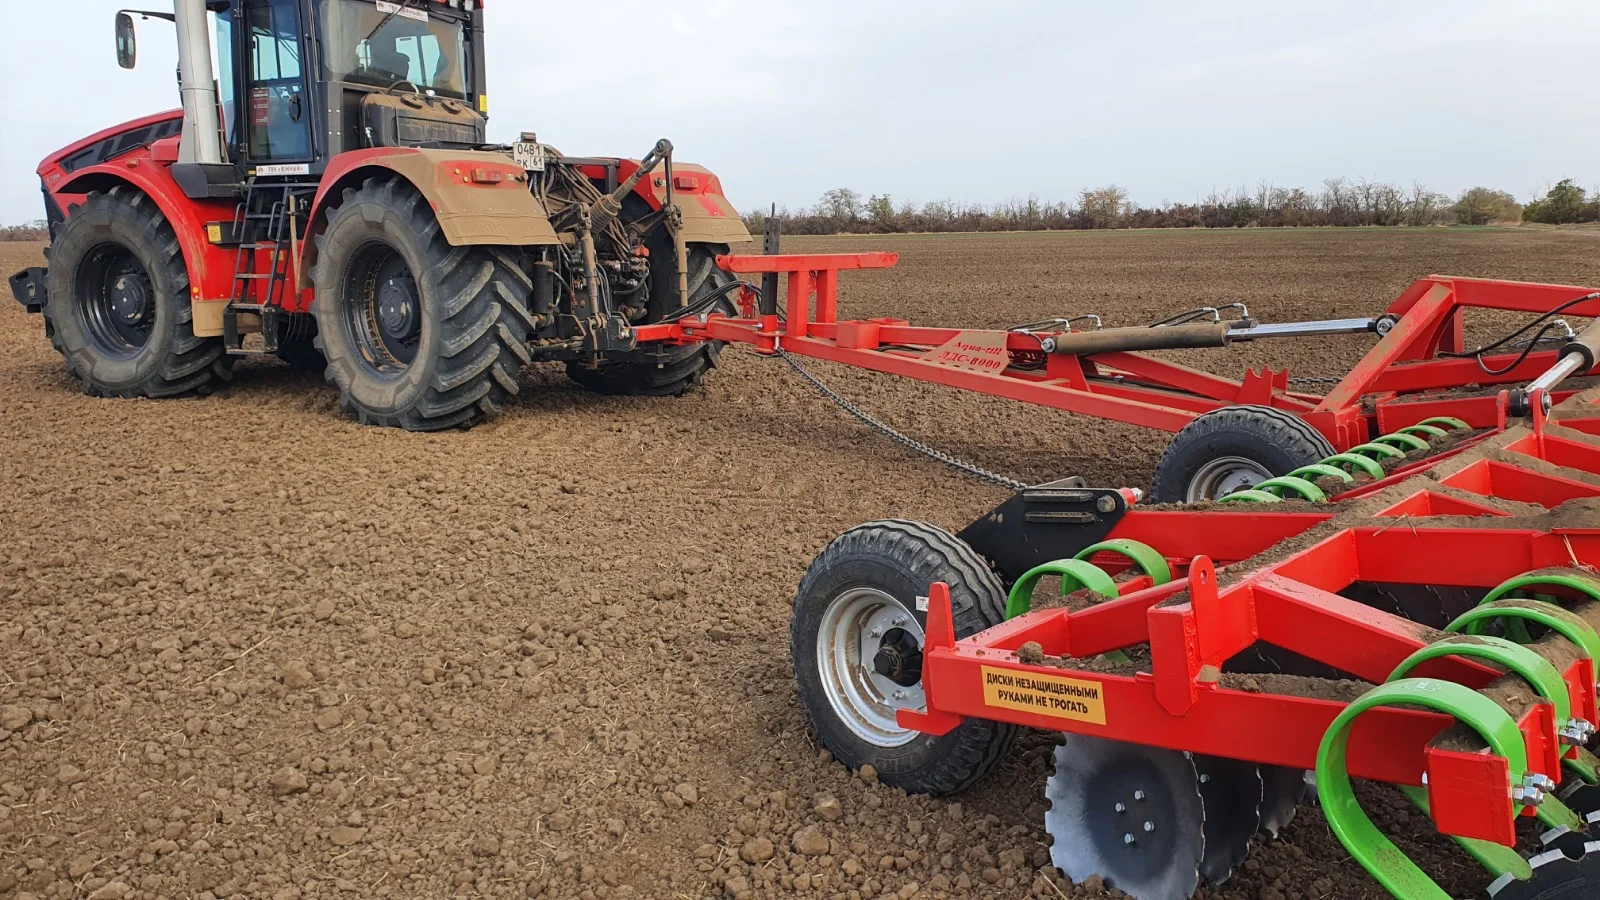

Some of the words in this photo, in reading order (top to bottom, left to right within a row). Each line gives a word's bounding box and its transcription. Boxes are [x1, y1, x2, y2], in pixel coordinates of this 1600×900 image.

[517, 144, 540, 155] 0481
[533, 157, 542, 166] 61
[938, 351, 1000, 369] ЛДС-8000
[986, 672, 1014, 685] ДИСКИ
[1015, 678, 1099, 700] НЕЗАЩИЩЕННЫМИ
[998, 689, 1034, 705] РУКАМИ
[1035, 696, 1048, 707] НЕ
[1048, 697, 1088, 714] ТРОГАТЬ
